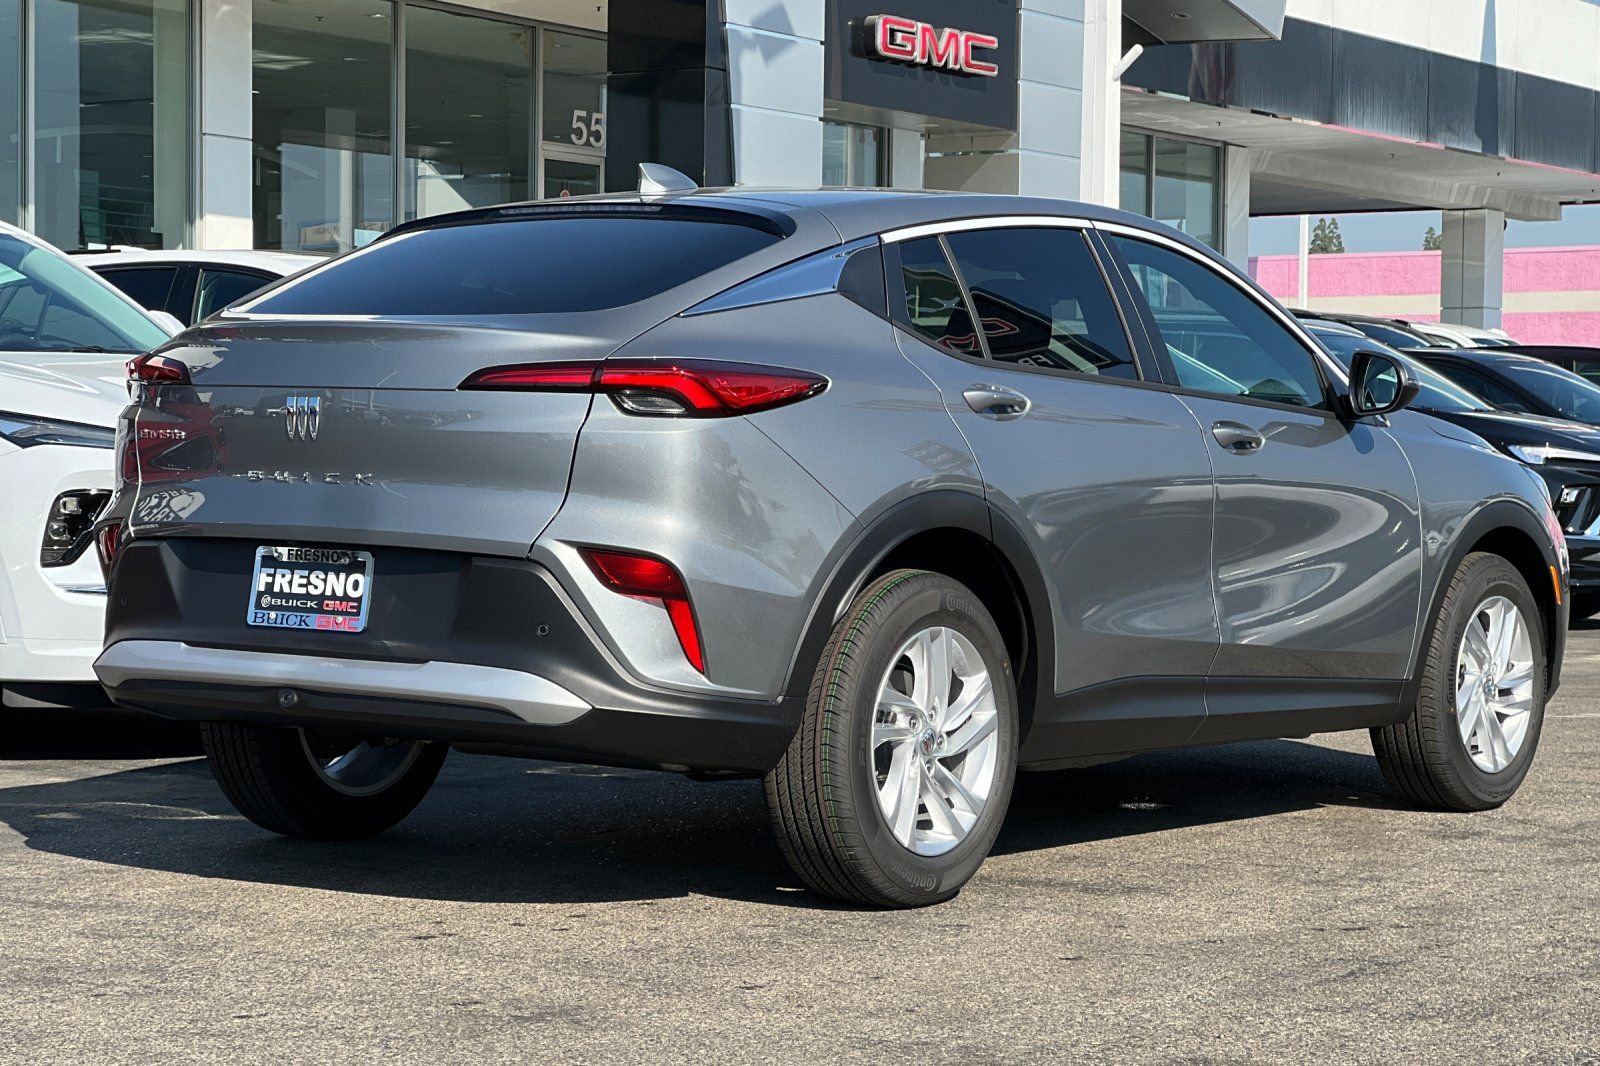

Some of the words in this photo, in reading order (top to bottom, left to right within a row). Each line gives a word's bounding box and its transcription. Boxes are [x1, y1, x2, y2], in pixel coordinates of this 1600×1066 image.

[874, 14, 998, 77] GMC
[570, 109, 606, 148] 55
[247, 470, 374, 485] BUICK
[287, 548, 340, 563] FRESNO
[258, 568, 365, 598] FRESNO
[271, 598, 318, 608] BUICK
[323, 600, 358, 612] GMC
[252, 612, 311, 627] BUICK
[316, 615, 360, 630] GMC
